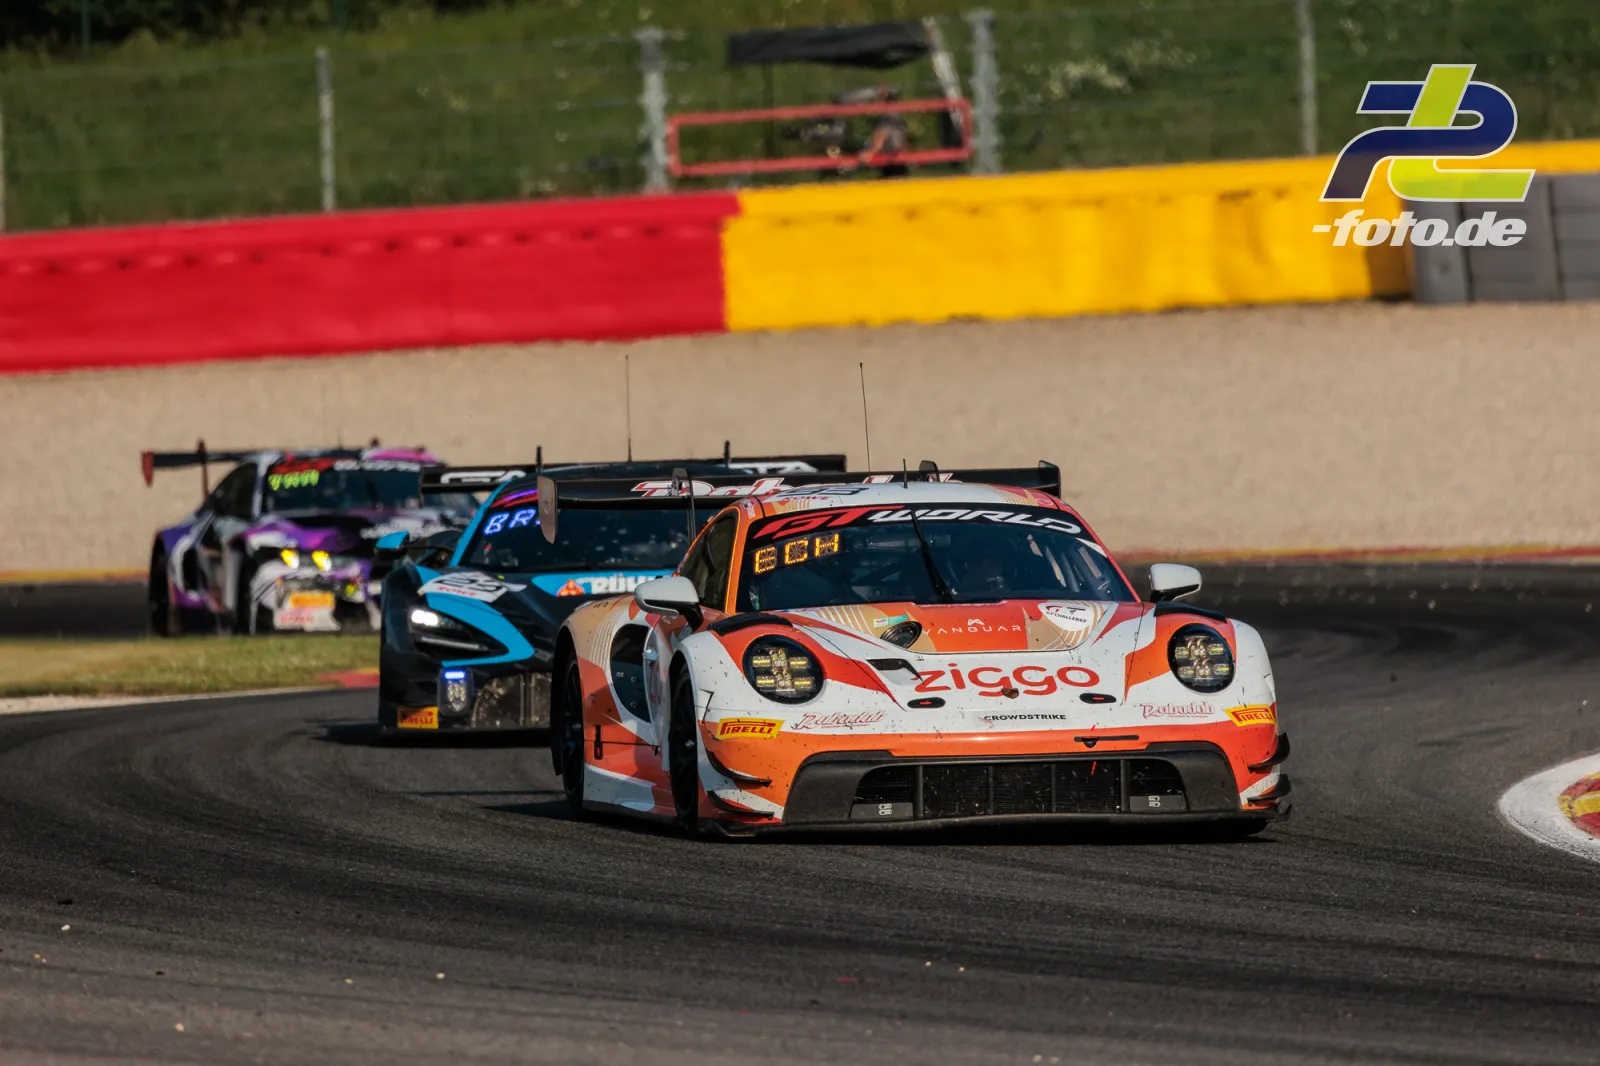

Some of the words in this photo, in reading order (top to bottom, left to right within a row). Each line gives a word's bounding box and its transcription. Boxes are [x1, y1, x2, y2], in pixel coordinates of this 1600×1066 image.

[484, 507, 541, 535] BR
[753, 505, 905, 539] GT
[867, 509, 1082, 535] WORLD
[754, 532, 840, 575] ECH
[911, 662, 1100, 698] ziggo
[720, 721, 777, 736] PIRELLI
[983, 713, 1067, 721] CROWDSTRIKE
